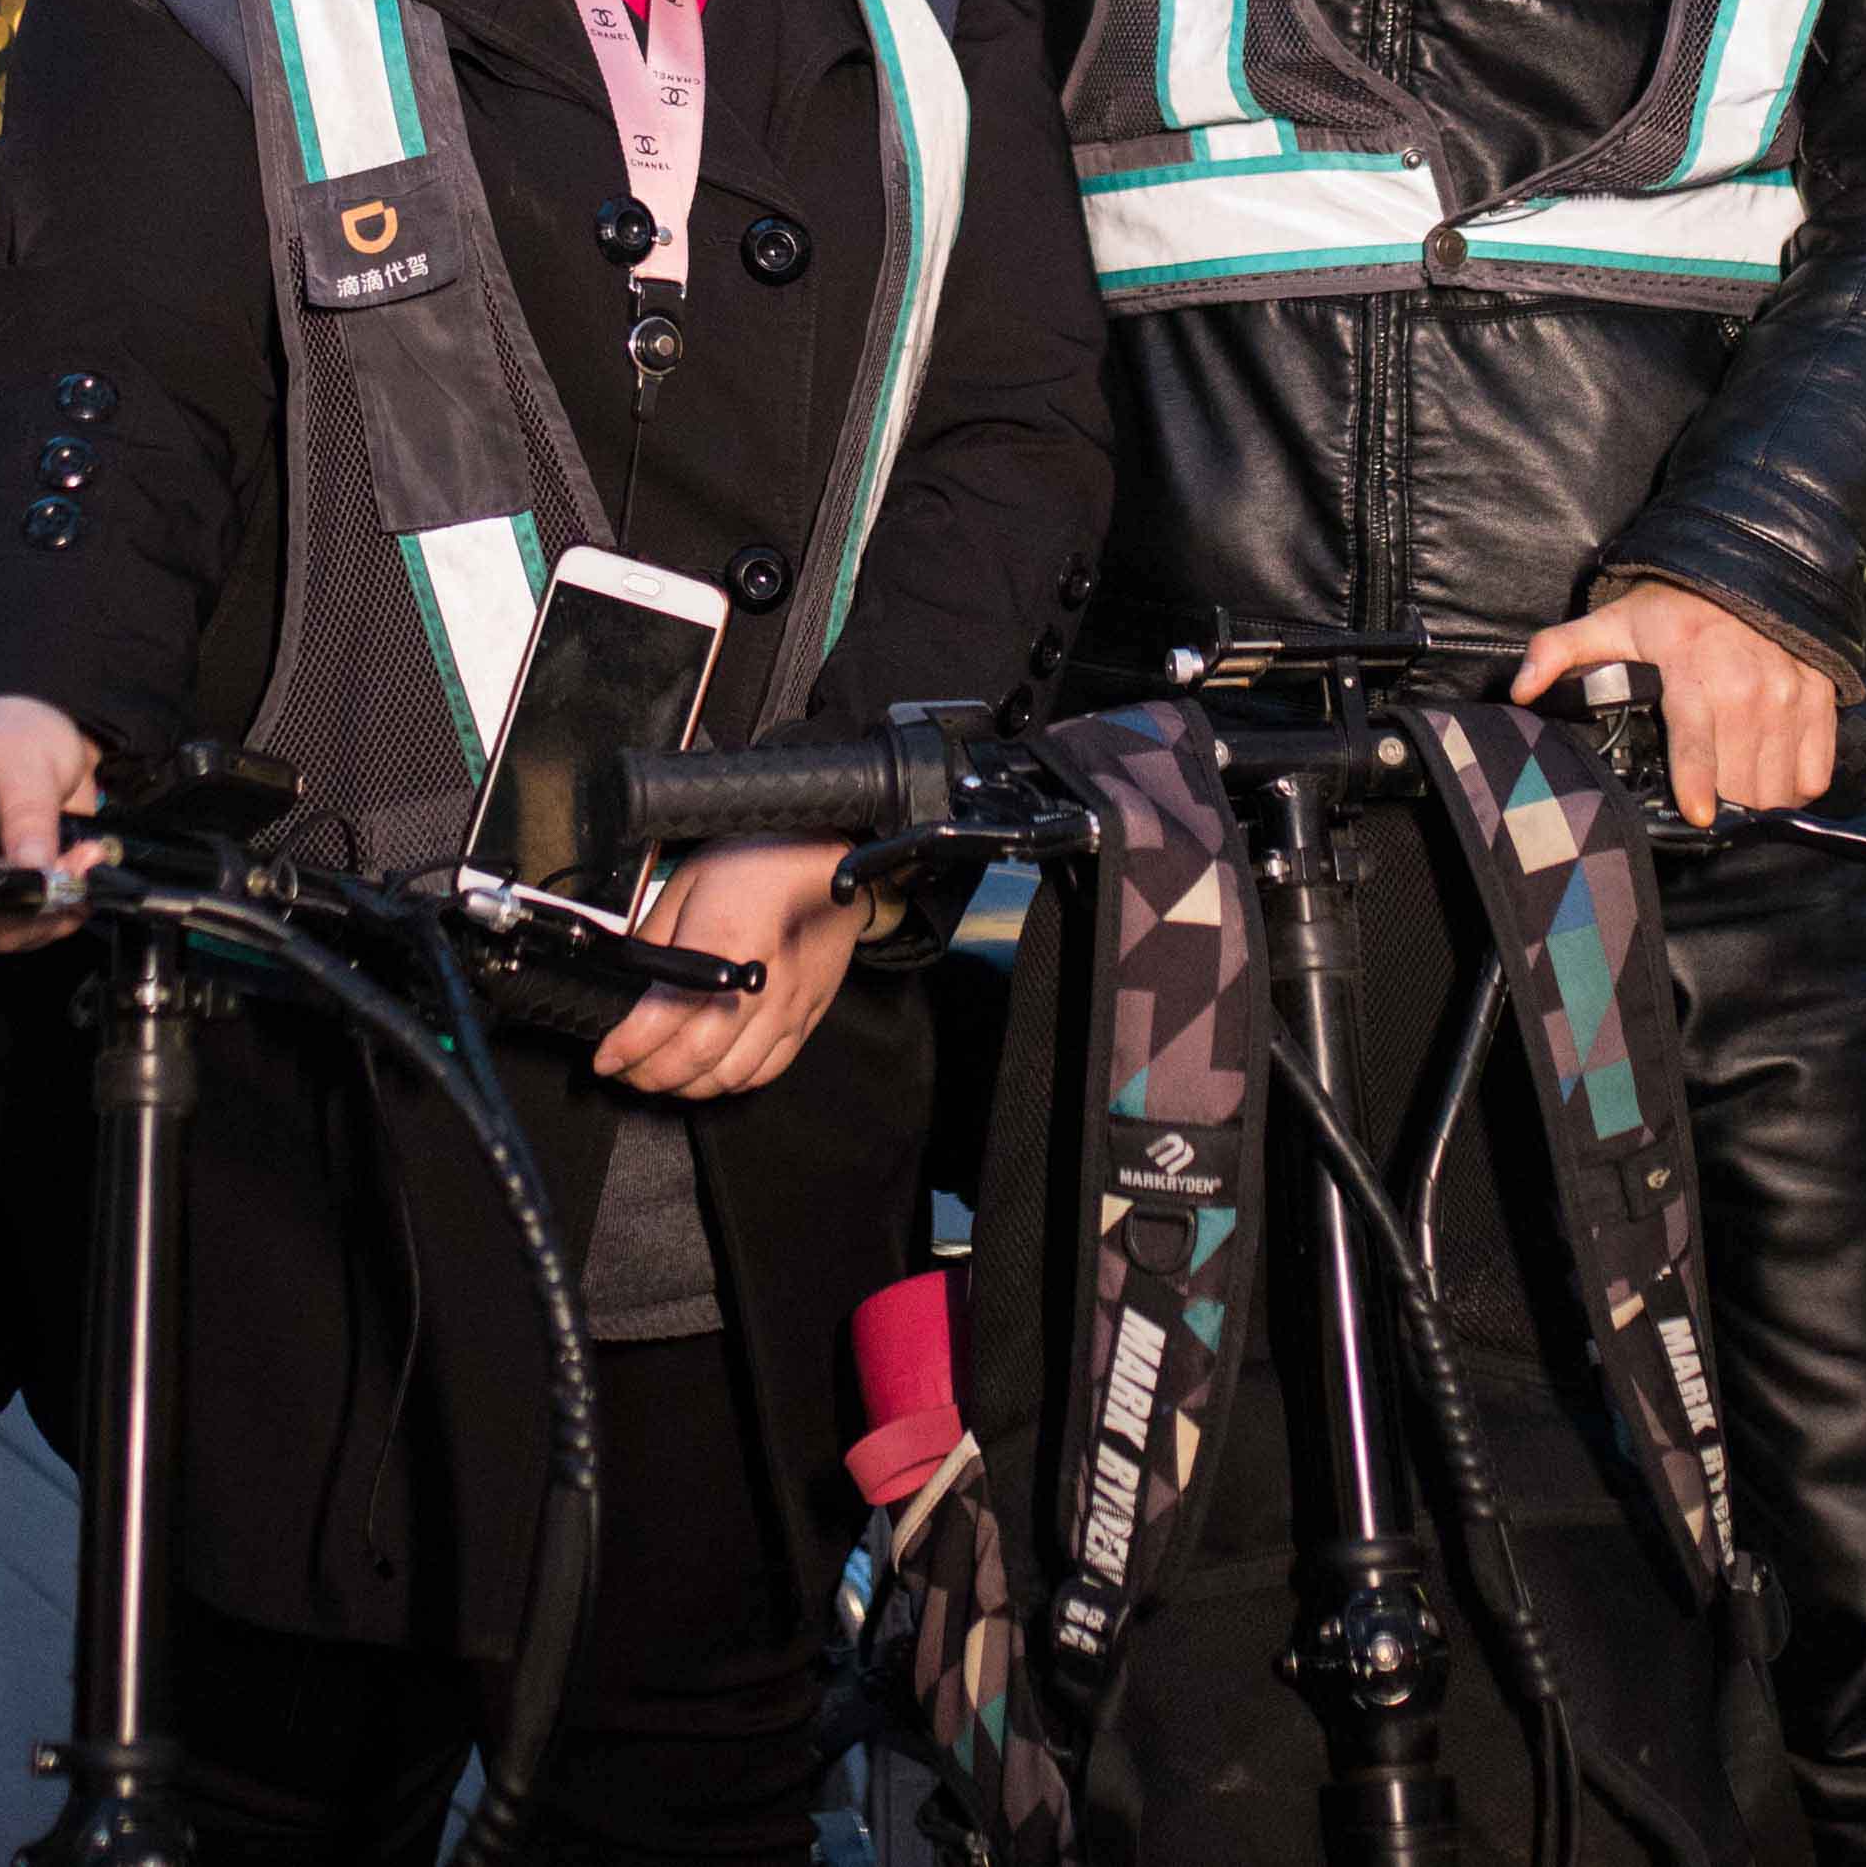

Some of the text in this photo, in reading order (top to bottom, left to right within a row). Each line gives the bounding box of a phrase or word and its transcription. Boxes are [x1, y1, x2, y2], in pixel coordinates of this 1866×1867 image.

[589, 27, 631, 41] CHANEL
[652, 70, 701, 85] CHANEL
[630, 158, 672, 172] CHANEL
[336, 253, 430, 298] 滴滴代驾
[1103, 1305, 1167, 1452] MARK
[1657, 1316, 1717, 1437] MARK
